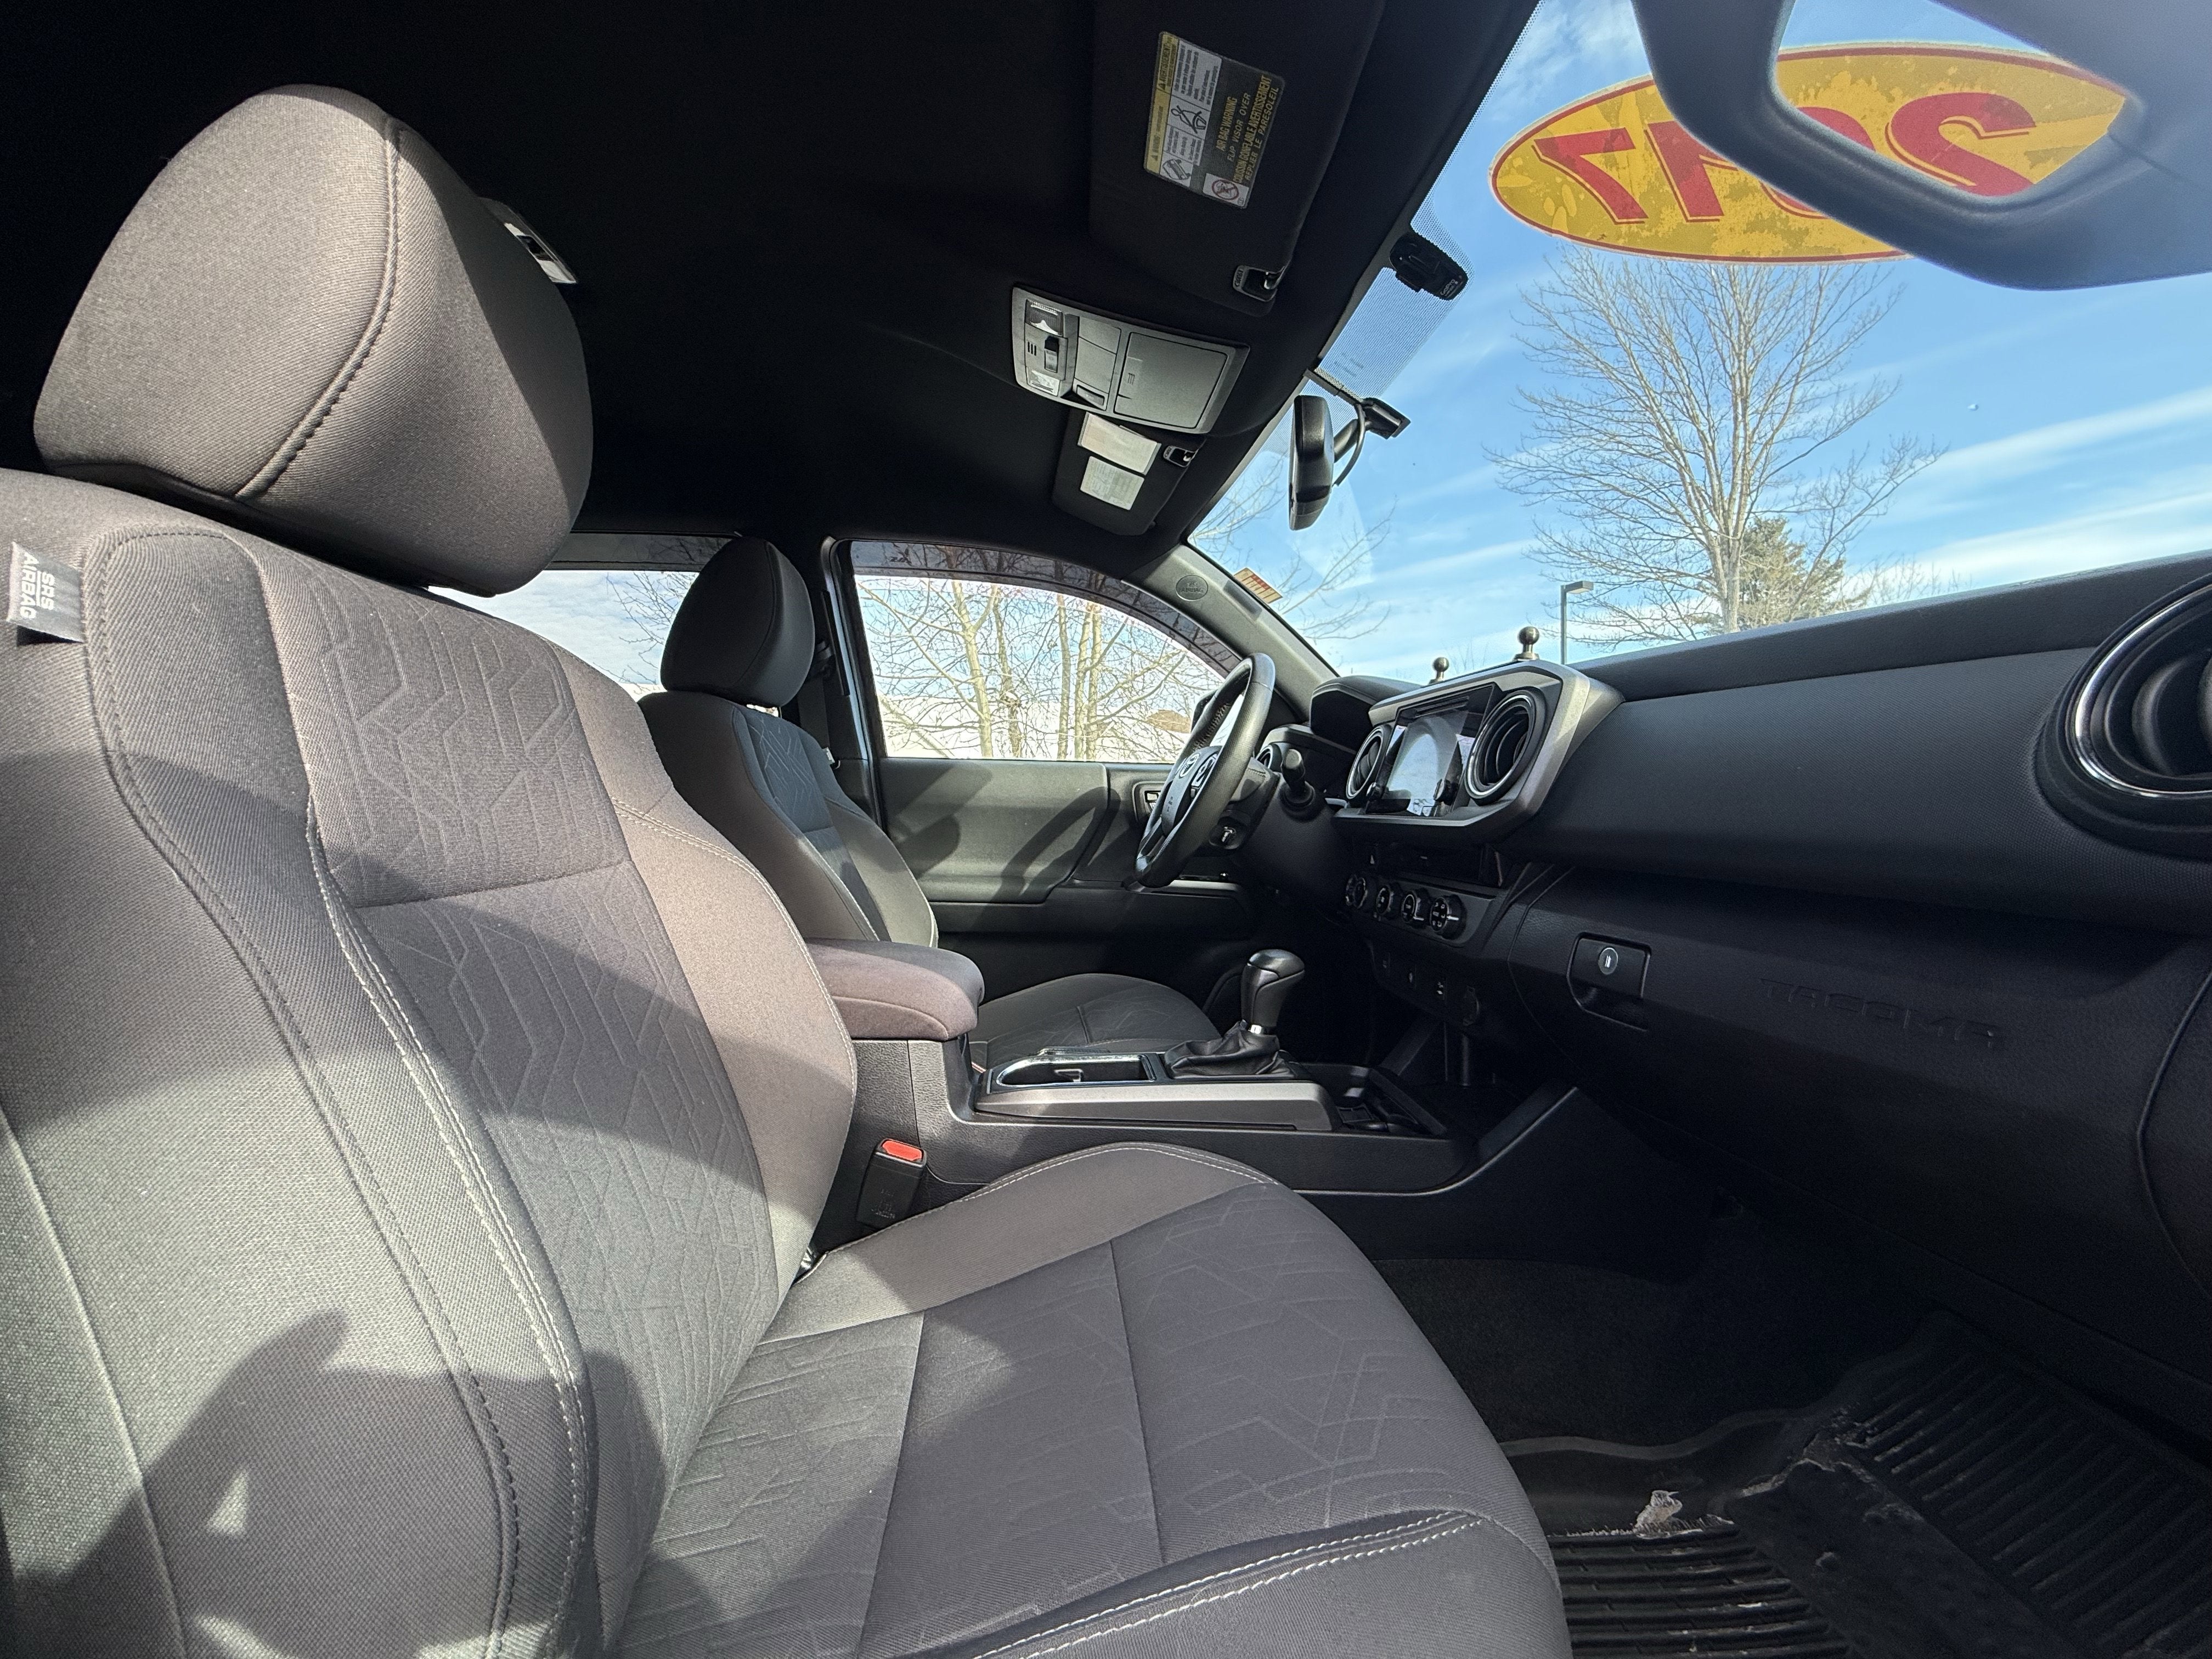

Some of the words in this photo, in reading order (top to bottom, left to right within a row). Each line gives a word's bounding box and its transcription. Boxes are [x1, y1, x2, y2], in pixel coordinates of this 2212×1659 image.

[1221, 97, 1237, 127] WARNING
[1227, 145, 1236, 162] FLIP
[1232, 119, 1244, 143] VISOR
[1240, 93, 1251, 115] OVER
[1216, 139, 1227, 151] AIR
[1218, 127, 1229, 140] BAG
[1244, 151, 1259, 180] REPLIER
[1254, 138, 1262, 149] LE
[1258, 88, 1279, 136] PARESOLEIL
[20, 551, 40, 619] AIRBAG
[41, 571, 56, 611] SRS
